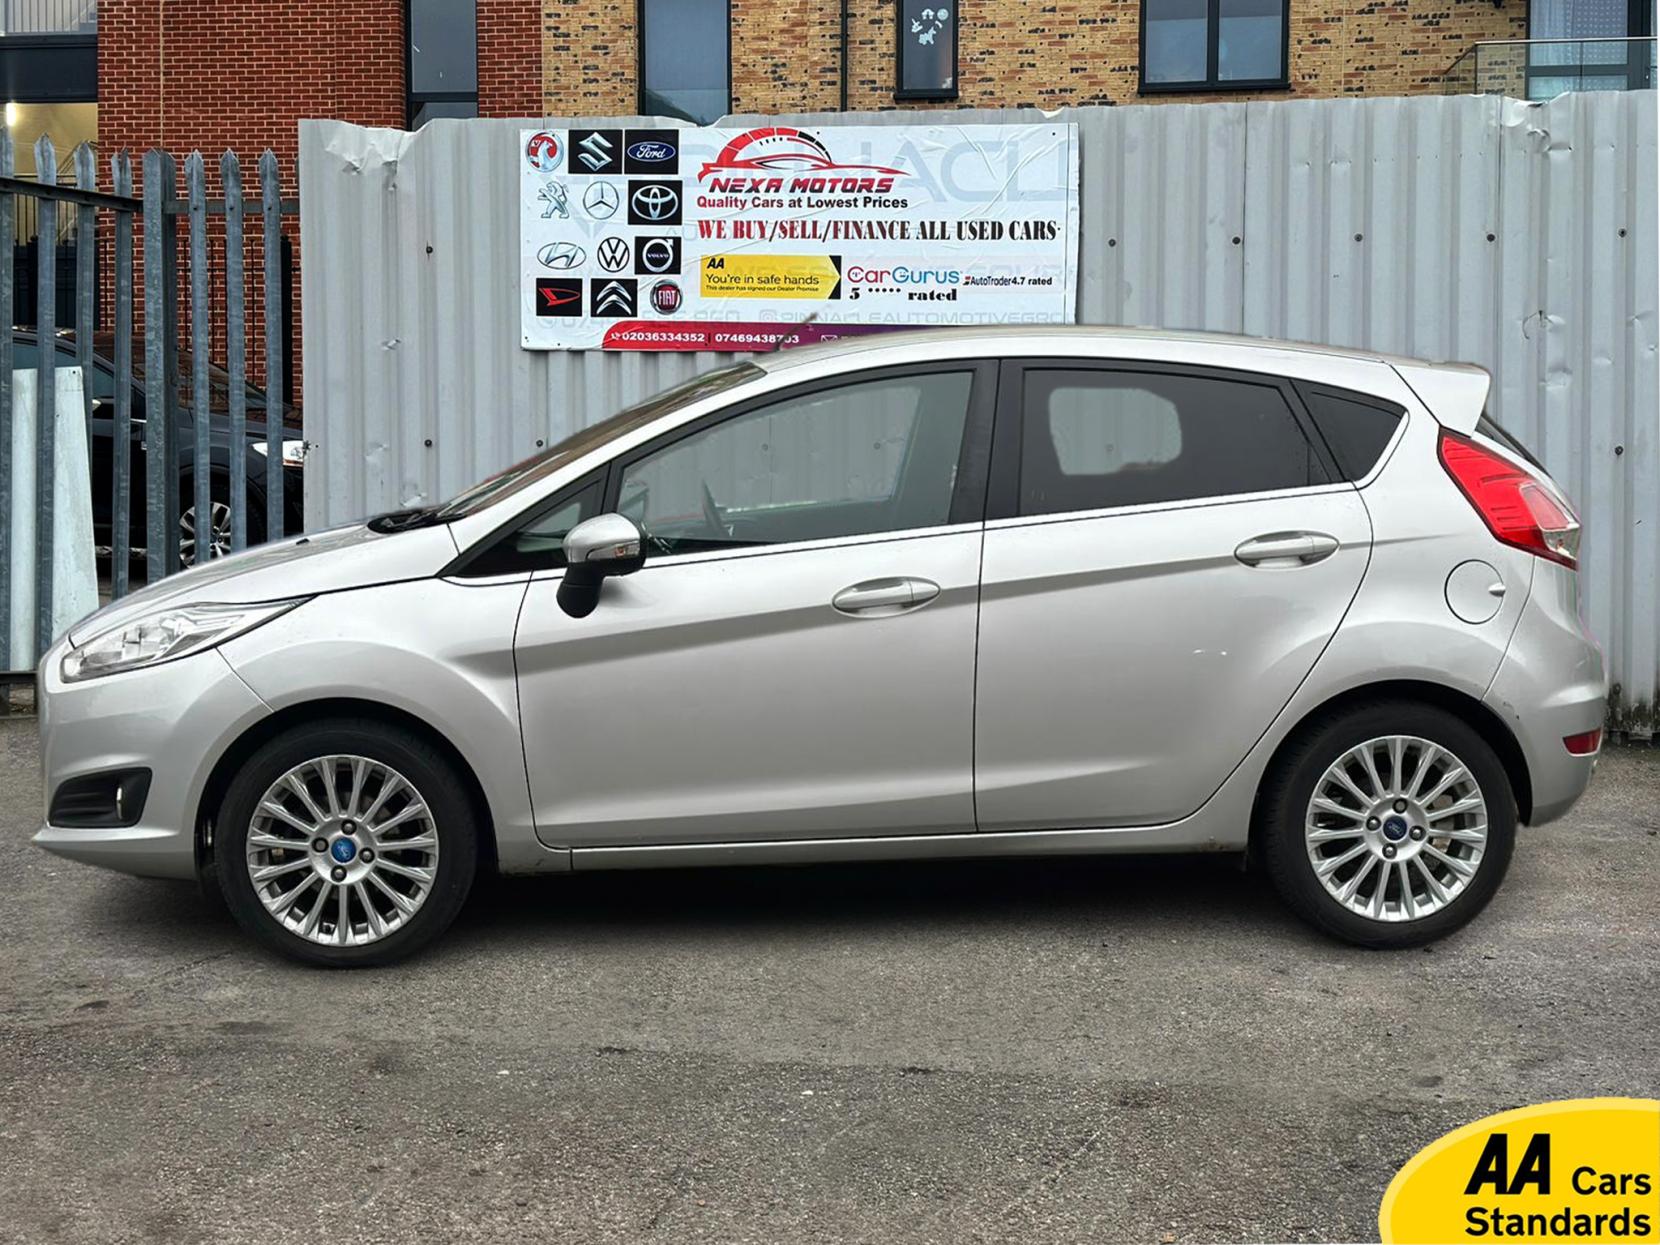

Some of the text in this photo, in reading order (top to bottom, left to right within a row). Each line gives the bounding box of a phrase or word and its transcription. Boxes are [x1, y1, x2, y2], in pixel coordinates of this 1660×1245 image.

[636, 144, 666, 159] Ford
[709, 178, 894, 193] NEXA MOTORS
[697, 196, 908, 210] Quality Cars at Lowest Prices
[697, 220, 726, 239] WE
[916, 220, 950, 240] ALL
[956, 220, 1003, 240] USED
[1009, 220, 1056, 240] CARS
[706, 258, 725, 269] AA
[705, 274, 820, 285] You're in safe hands
[847, 266, 960, 284] CarGurus
[1028, 277, 1052, 286] rated
[658, 290, 676, 305] FIAT
[849, 287, 957, 301] 5 rated
[622, 333, 705, 342] 02036334352
